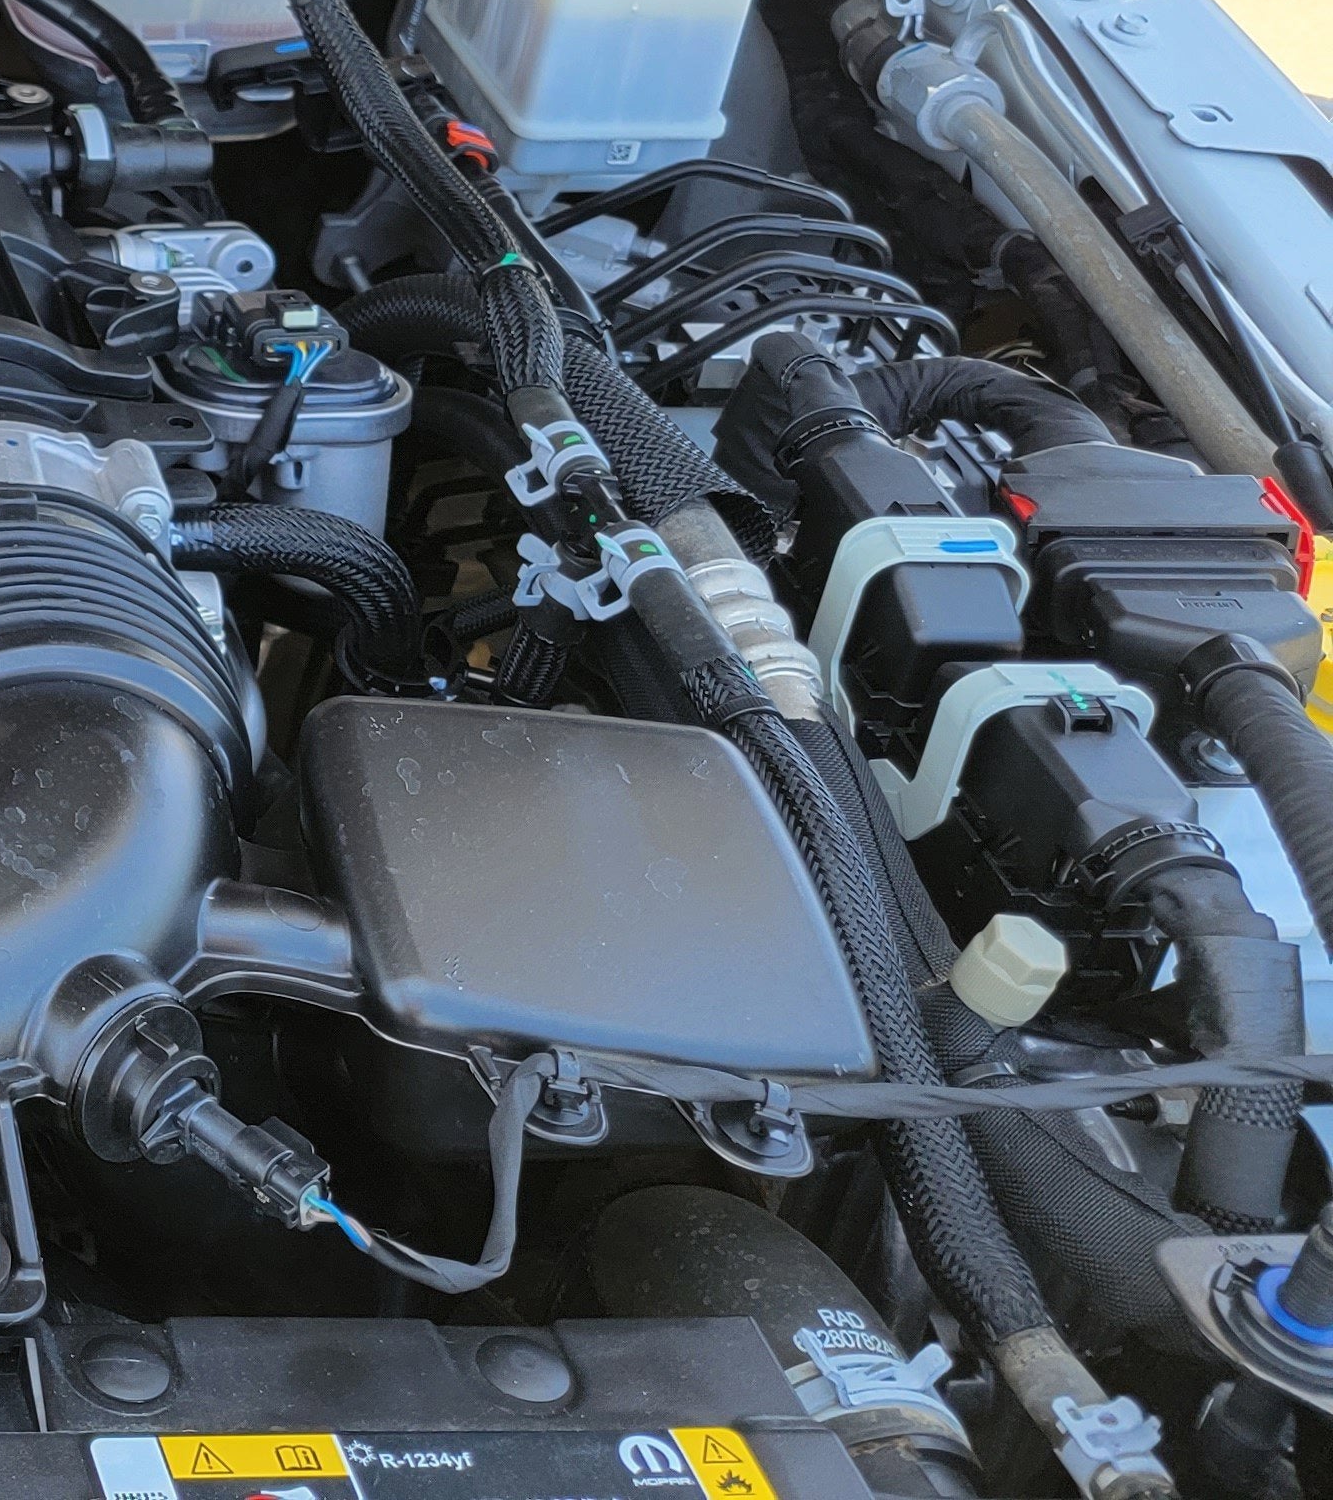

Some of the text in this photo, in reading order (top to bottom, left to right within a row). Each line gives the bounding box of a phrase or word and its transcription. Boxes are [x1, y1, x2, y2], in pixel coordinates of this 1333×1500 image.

[817, 1309, 866, 1330] RAD
[793, 1329, 904, 1358] 280782A
[378, 1451, 473, 1471] R-1234yf
[632, 1477, 695, 1487] MOPAR
